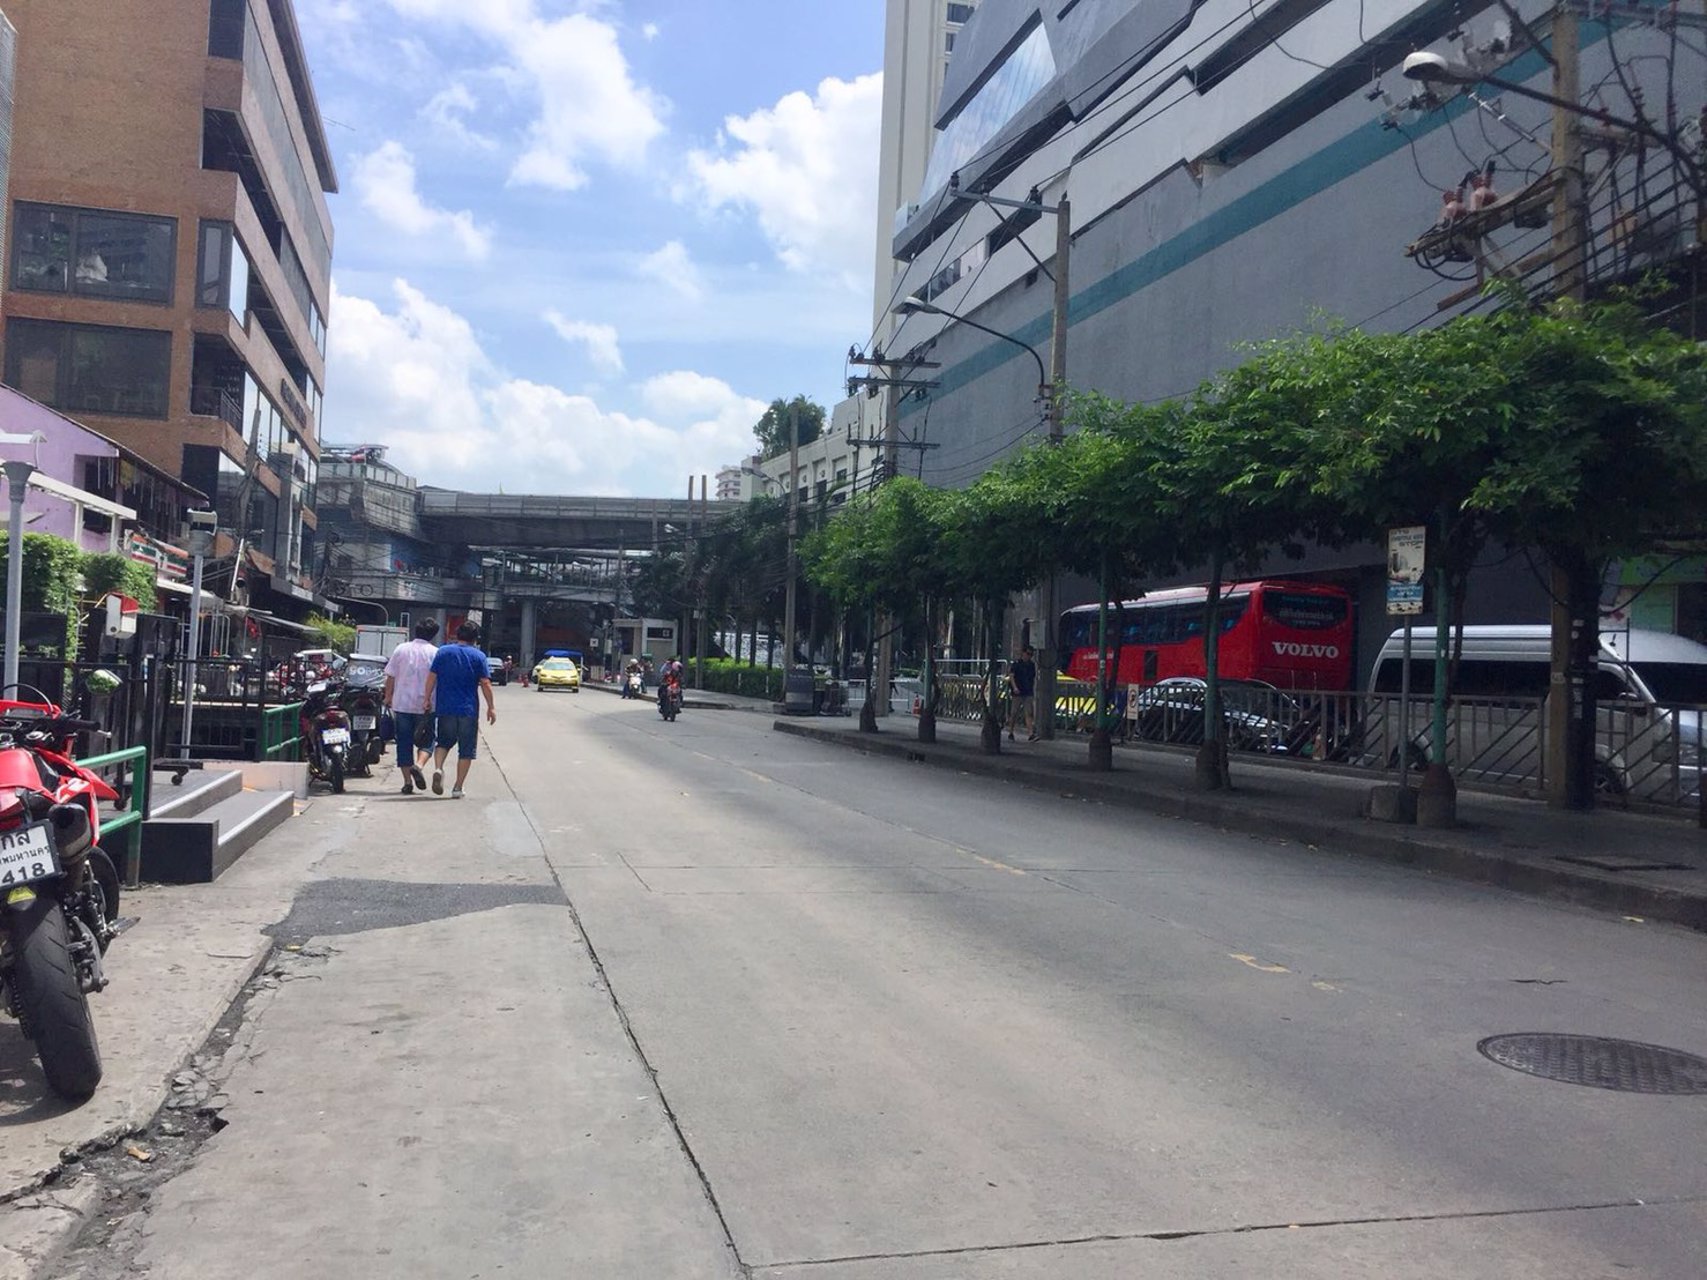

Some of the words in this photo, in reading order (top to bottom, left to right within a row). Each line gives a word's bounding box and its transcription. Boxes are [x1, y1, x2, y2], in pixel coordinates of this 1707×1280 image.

[1272, 641, 1339, 659] VOLVO
[0, 846, 50, 864] พมหานคร
[2, 862, 46, 884] 418
